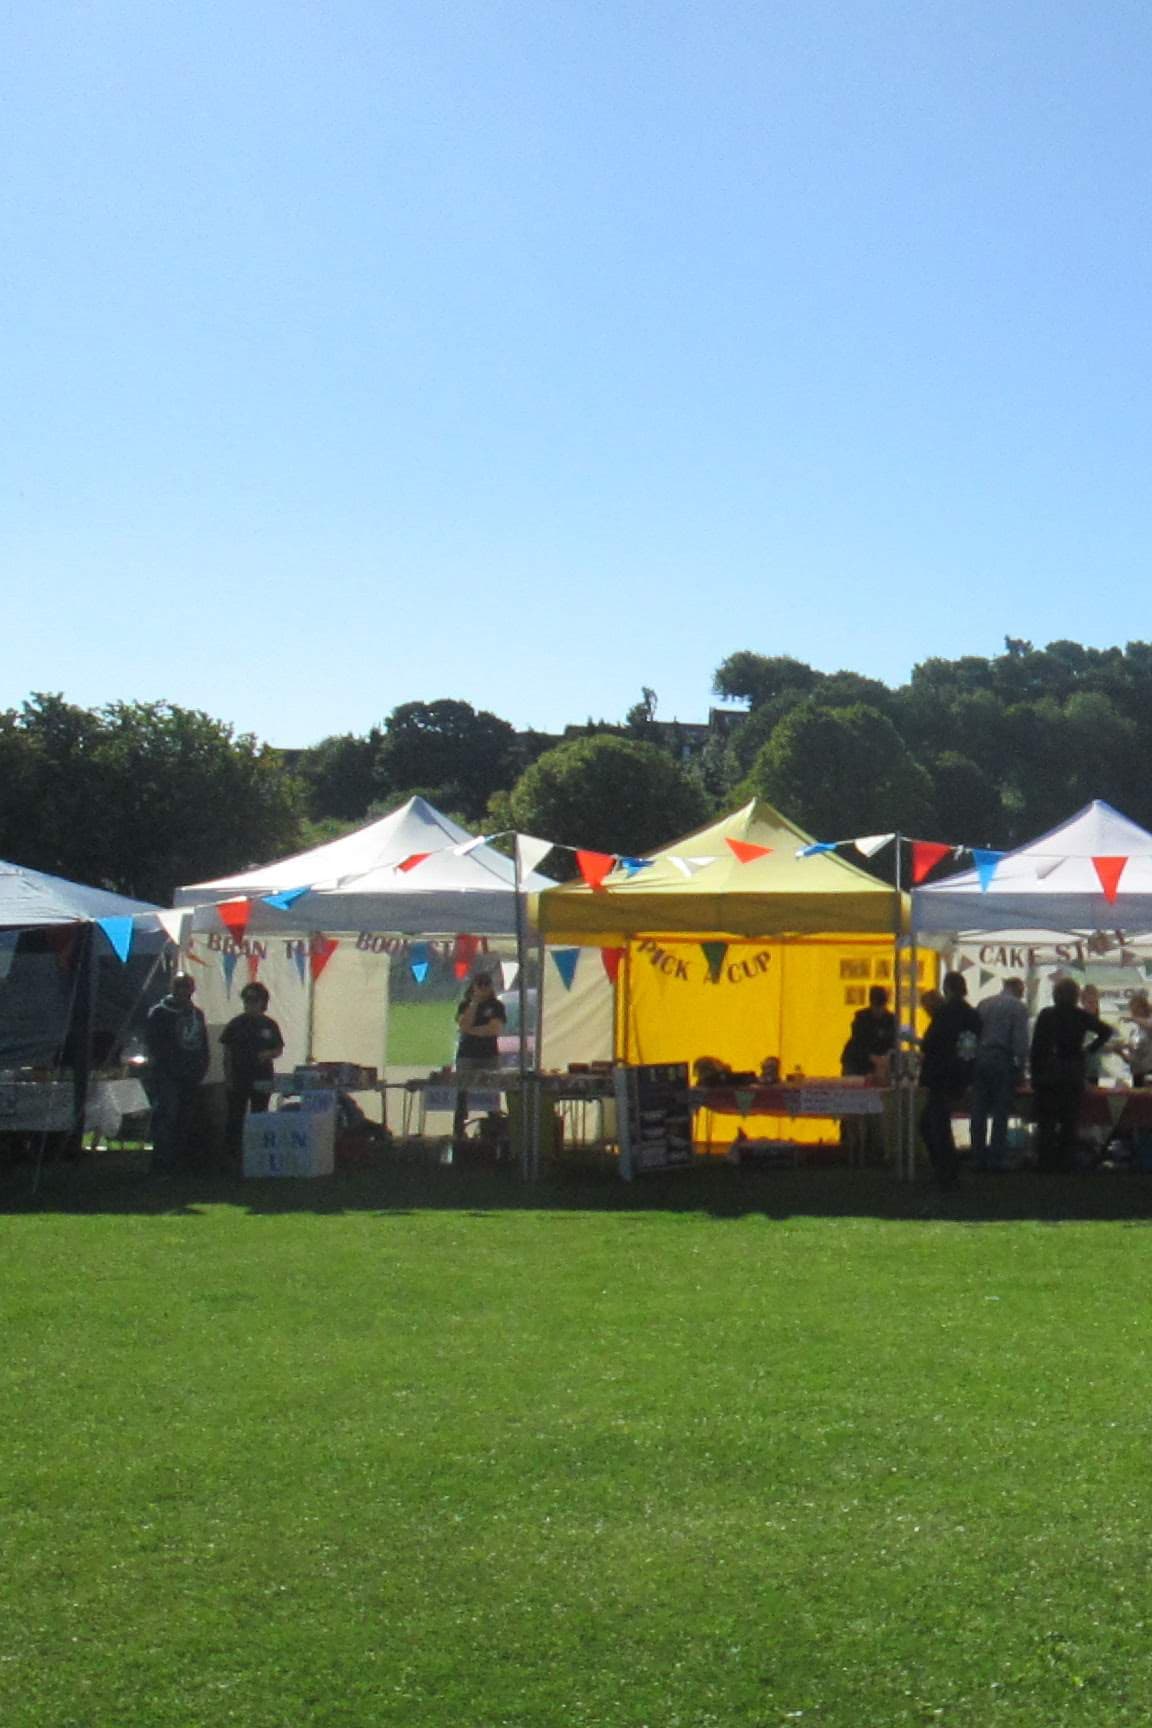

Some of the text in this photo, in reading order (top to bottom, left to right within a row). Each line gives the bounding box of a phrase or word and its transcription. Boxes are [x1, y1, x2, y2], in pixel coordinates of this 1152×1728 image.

[637, 940, 690, 981] PICK
[727, 951, 771, 983] CUP
[979, 943, 1041, 969] CAKE
